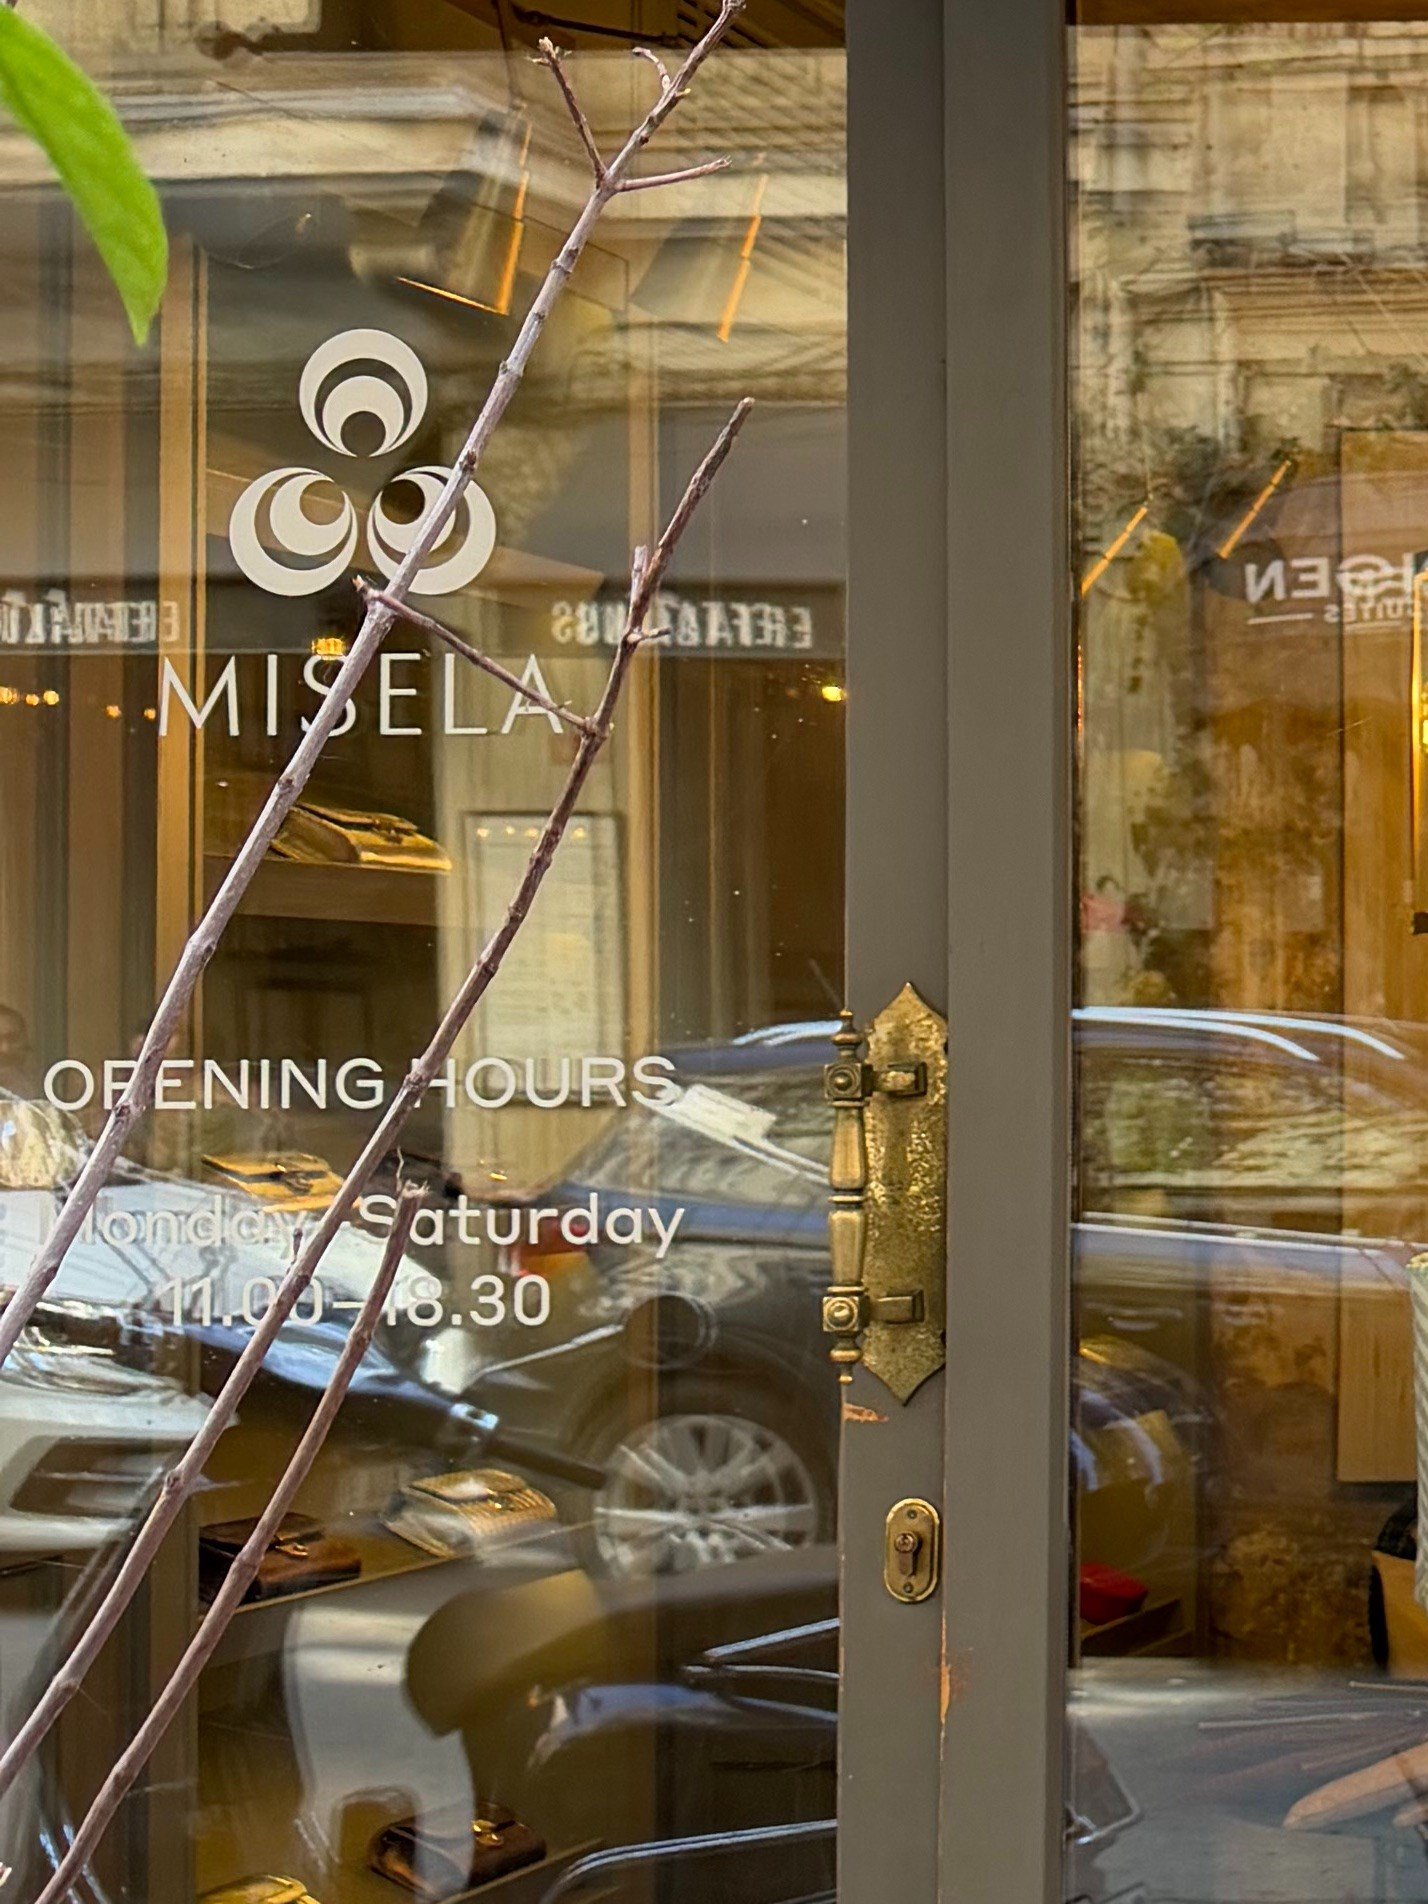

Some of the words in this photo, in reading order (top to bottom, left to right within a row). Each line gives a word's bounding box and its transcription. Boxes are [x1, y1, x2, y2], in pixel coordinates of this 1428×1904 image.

[158, 652, 564, 737] MISELA
[44, 1057, 384, 1111] OPENING
[413, 1056, 677, 1109] HOURS
[358, 1192, 686, 1259] Saturday
